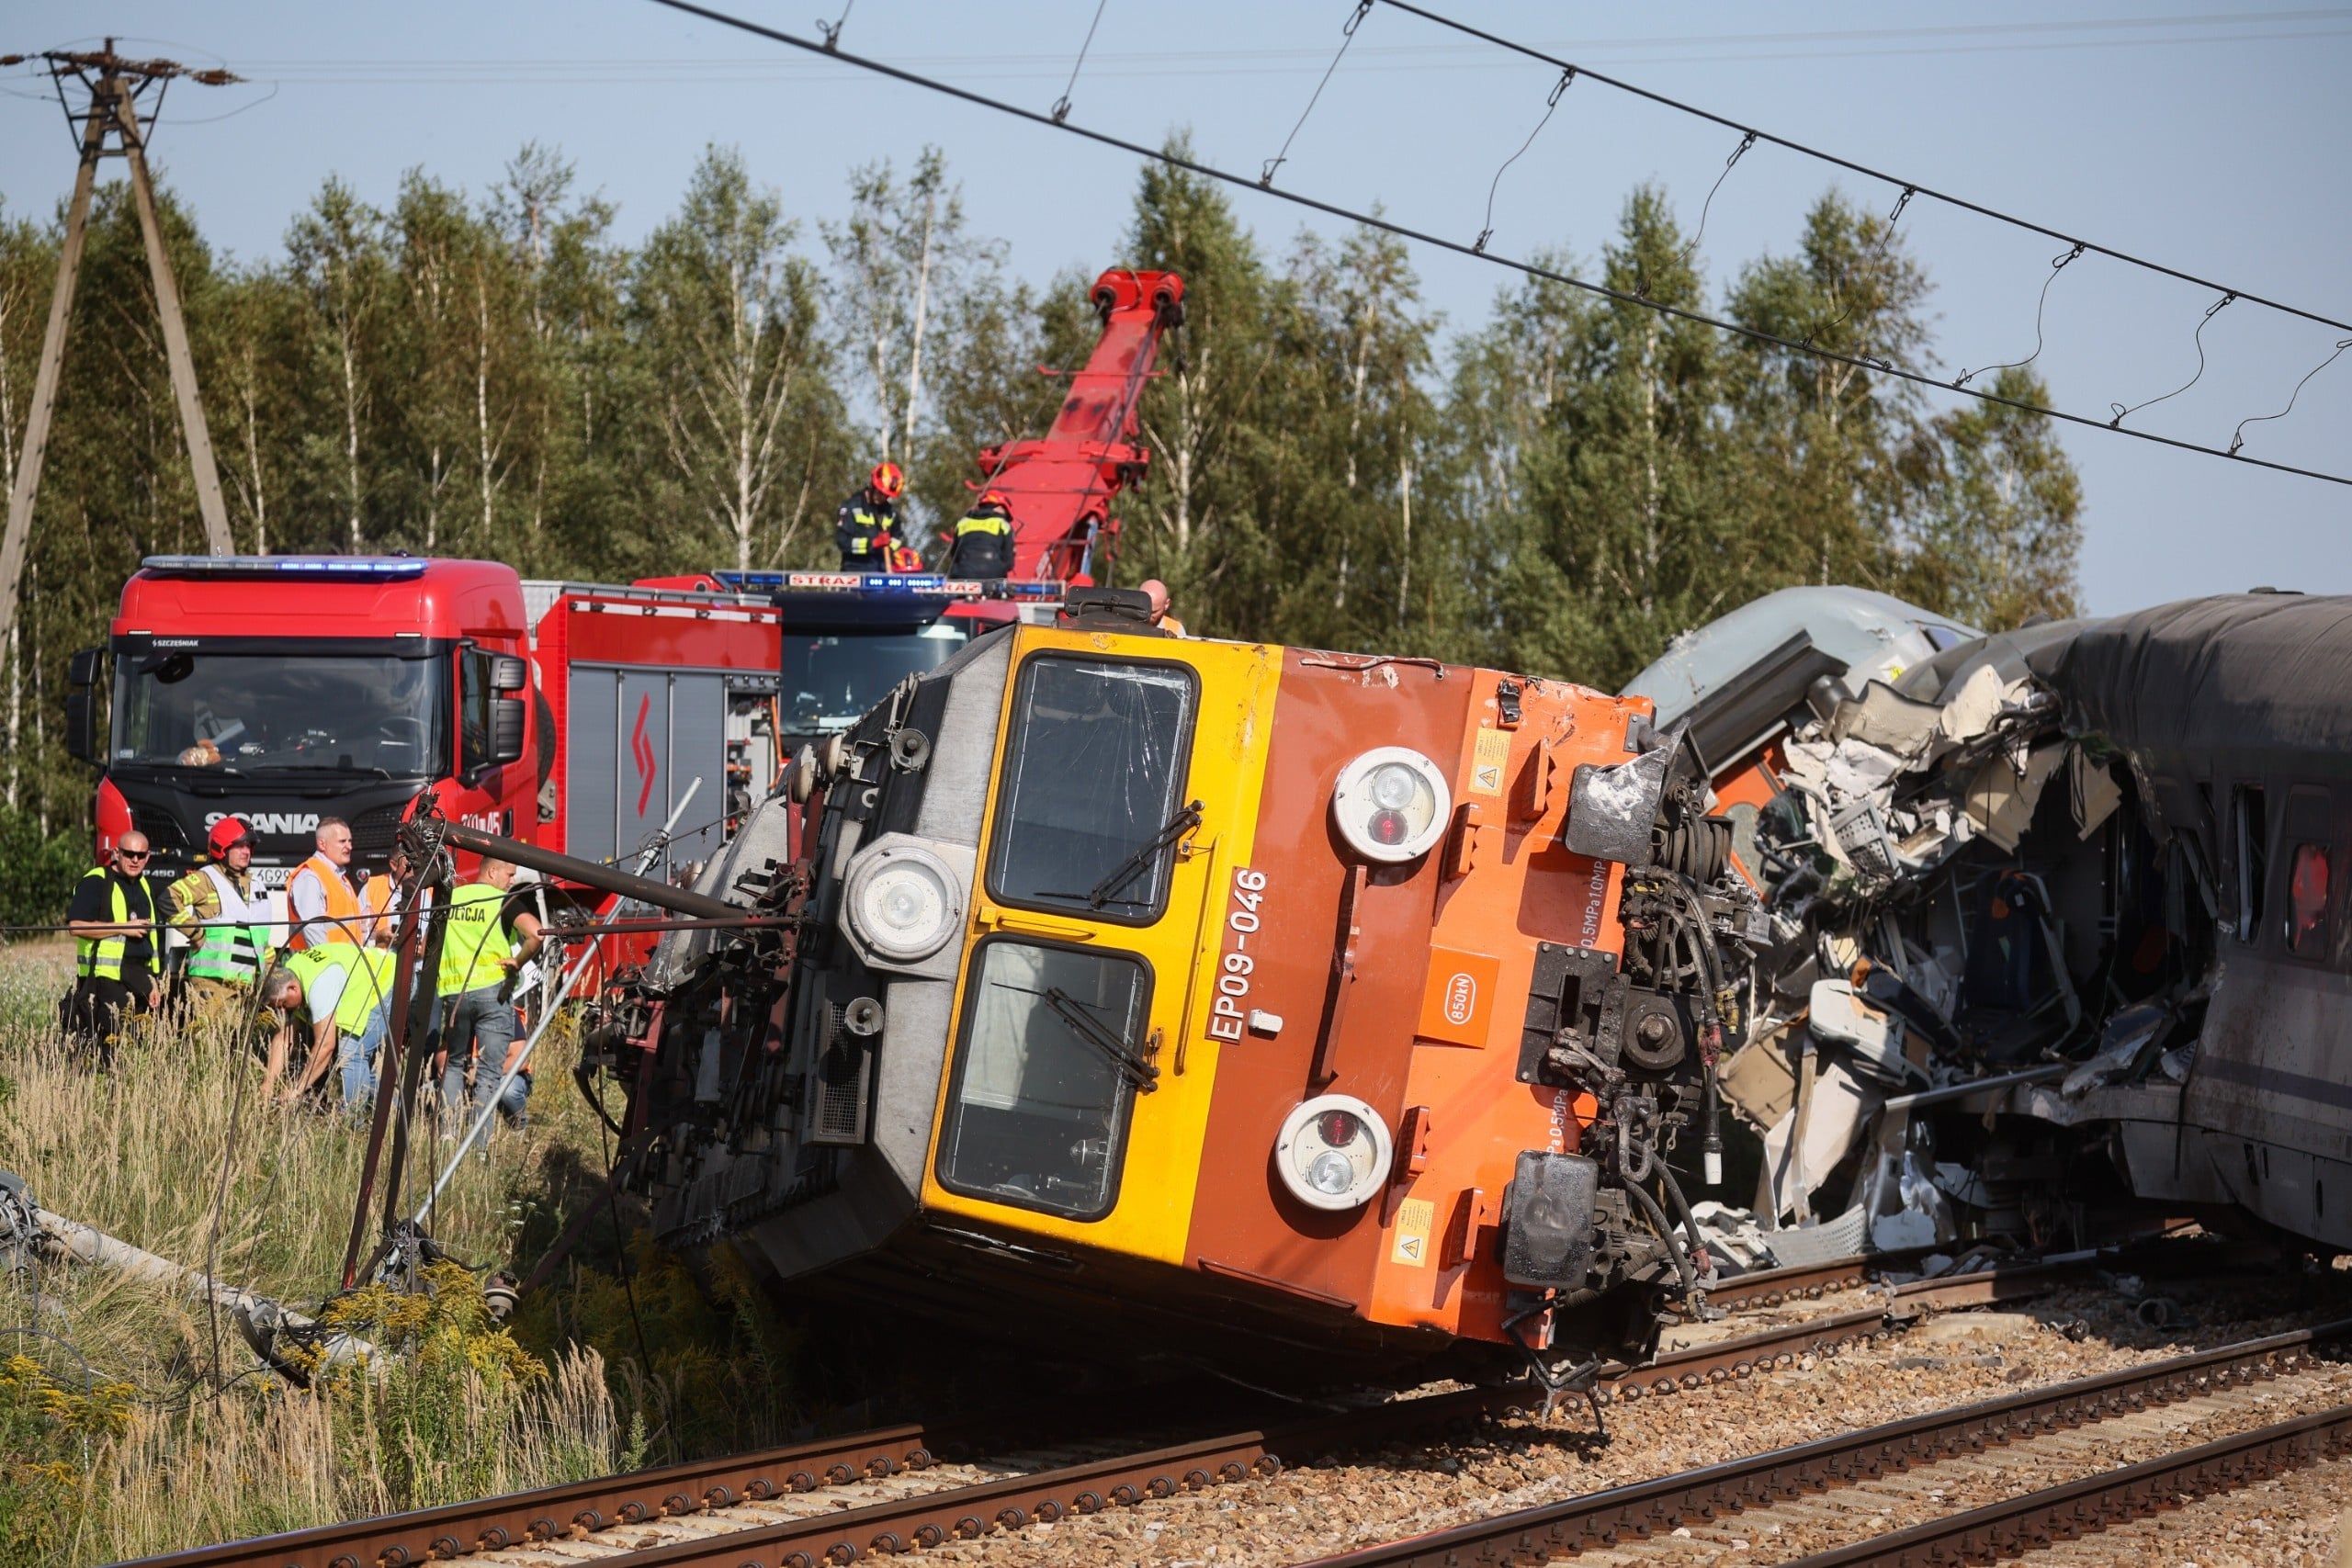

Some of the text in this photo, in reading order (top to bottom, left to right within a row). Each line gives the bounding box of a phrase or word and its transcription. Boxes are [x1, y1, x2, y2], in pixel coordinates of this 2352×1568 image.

[152, 869, 175, 878] 450
[1211, 869, 1267, 1040] EP09-046
[1451, 977, 1470, 1020] 850kN
